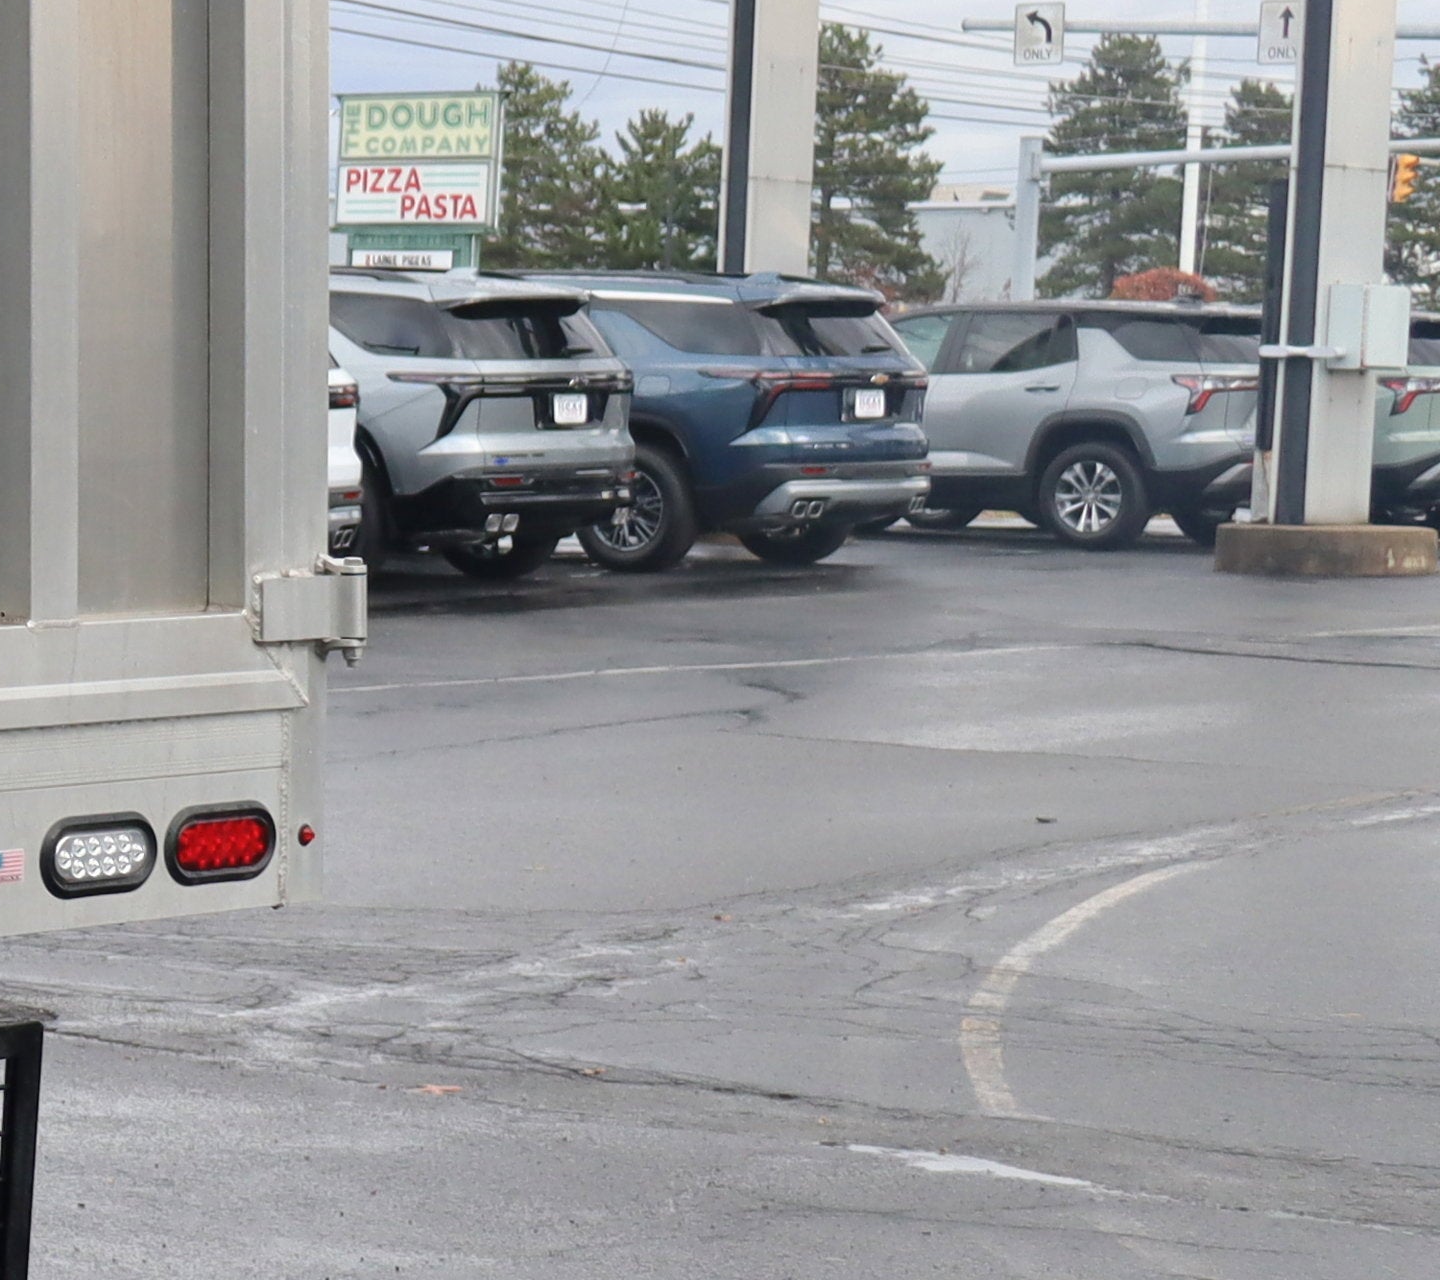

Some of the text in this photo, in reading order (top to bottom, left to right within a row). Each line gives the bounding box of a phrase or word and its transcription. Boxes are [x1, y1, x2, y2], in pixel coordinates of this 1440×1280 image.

[1023, 46, 1053, 61] ONLY
[366, 99, 492, 132] DOUGH
[344, 103, 362, 155] THE
[365, 135, 488, 155] COMPANY
[345, 167, 422, 194] PIZZA
[399, 194, 478, 220] PASTA
